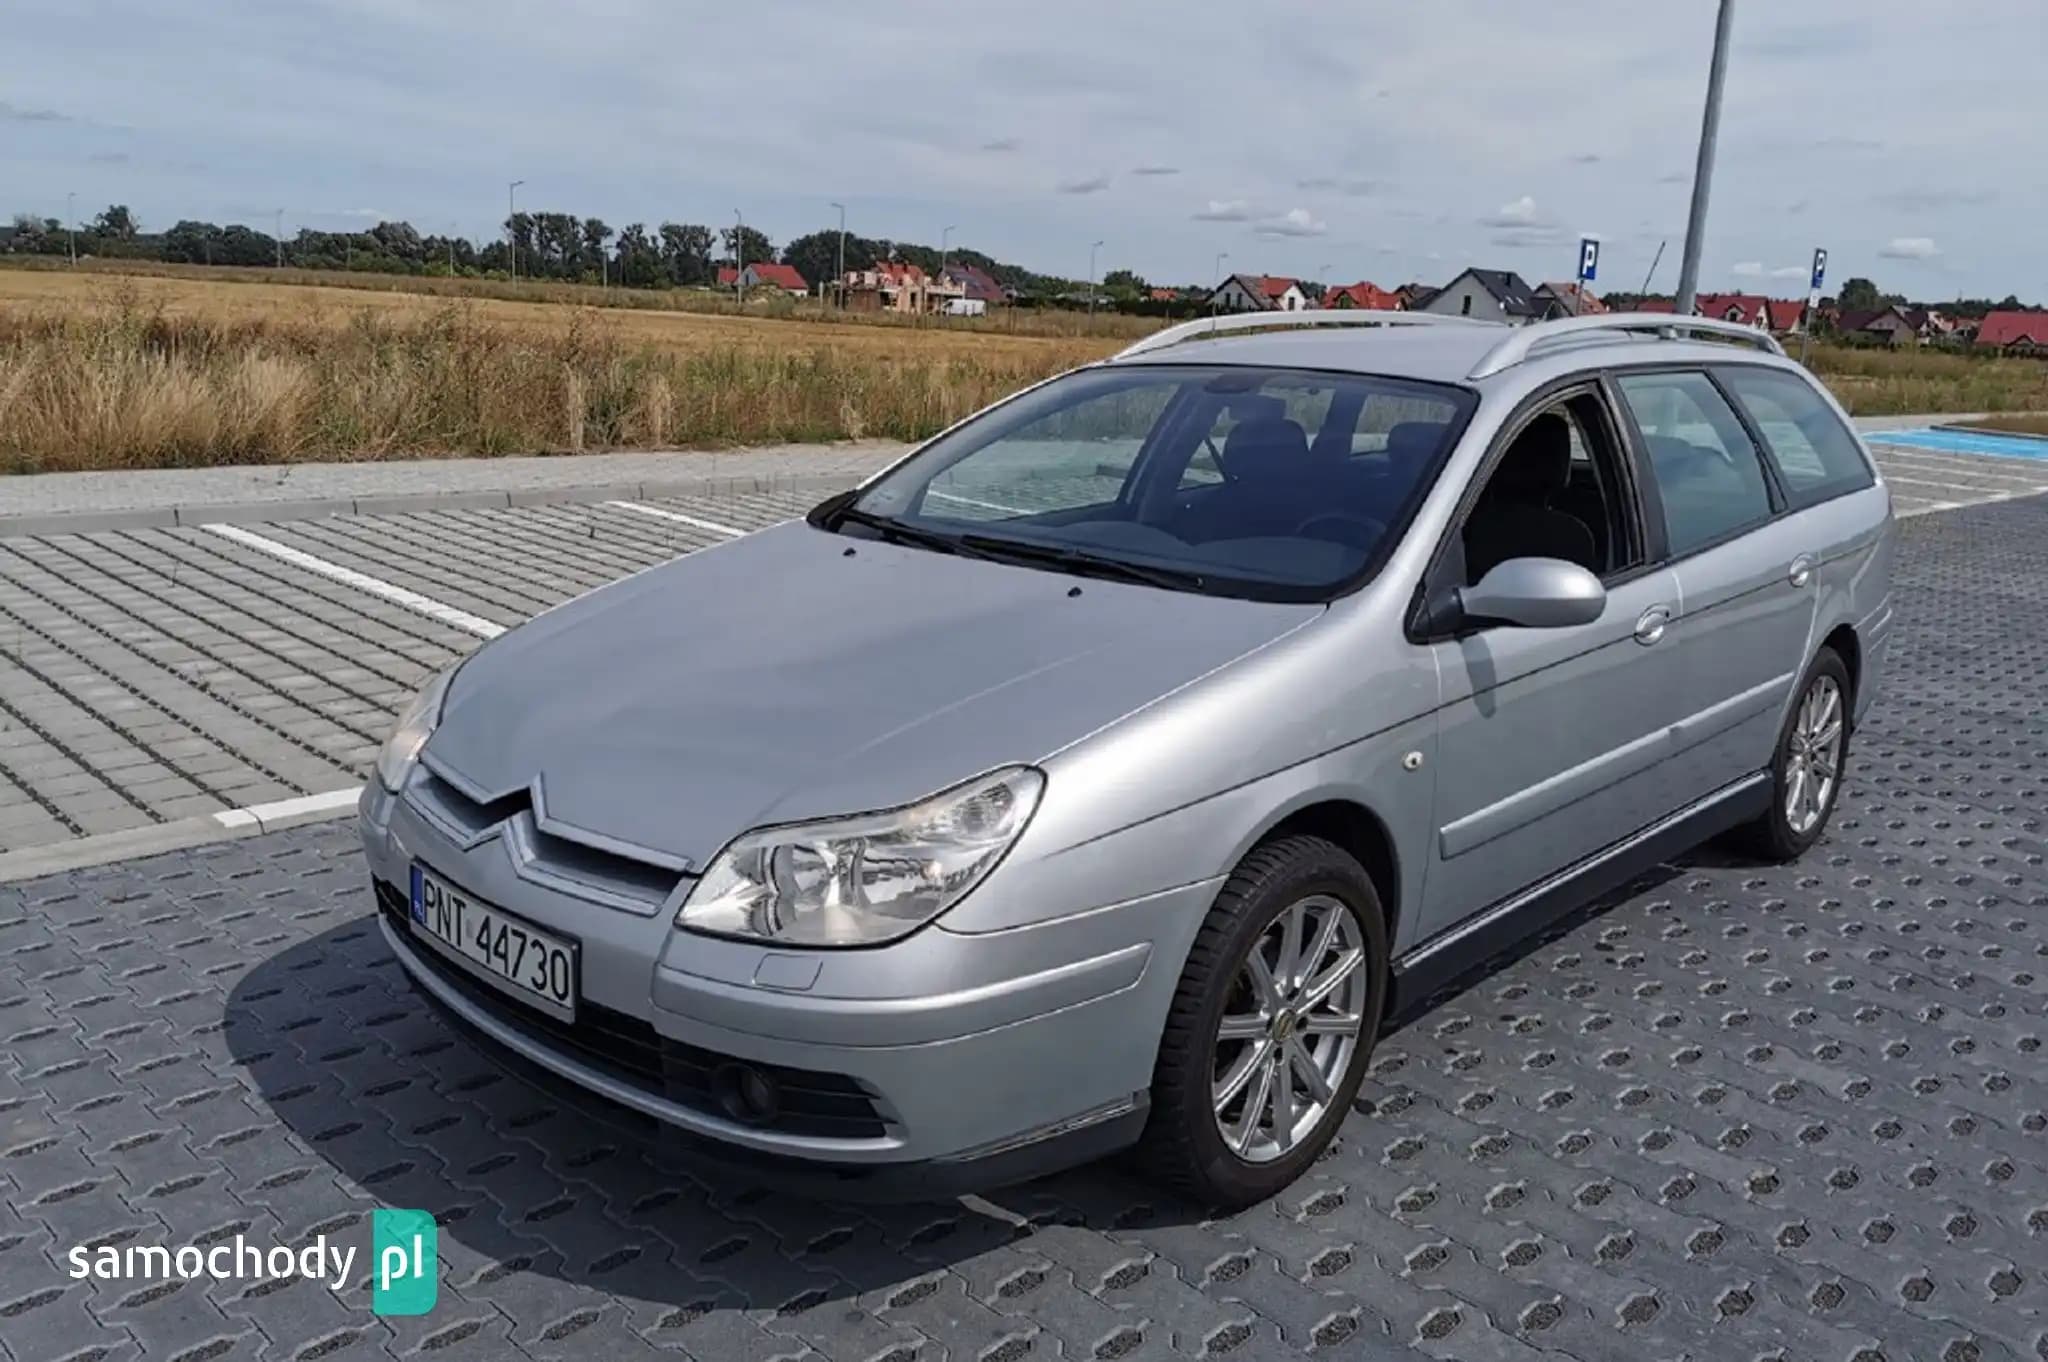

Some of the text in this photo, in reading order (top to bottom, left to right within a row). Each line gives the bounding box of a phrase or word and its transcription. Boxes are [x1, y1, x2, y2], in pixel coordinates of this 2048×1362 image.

[1582, 243, 1596, 272] P
[424, 878, 569, 1001] PNT 44730
